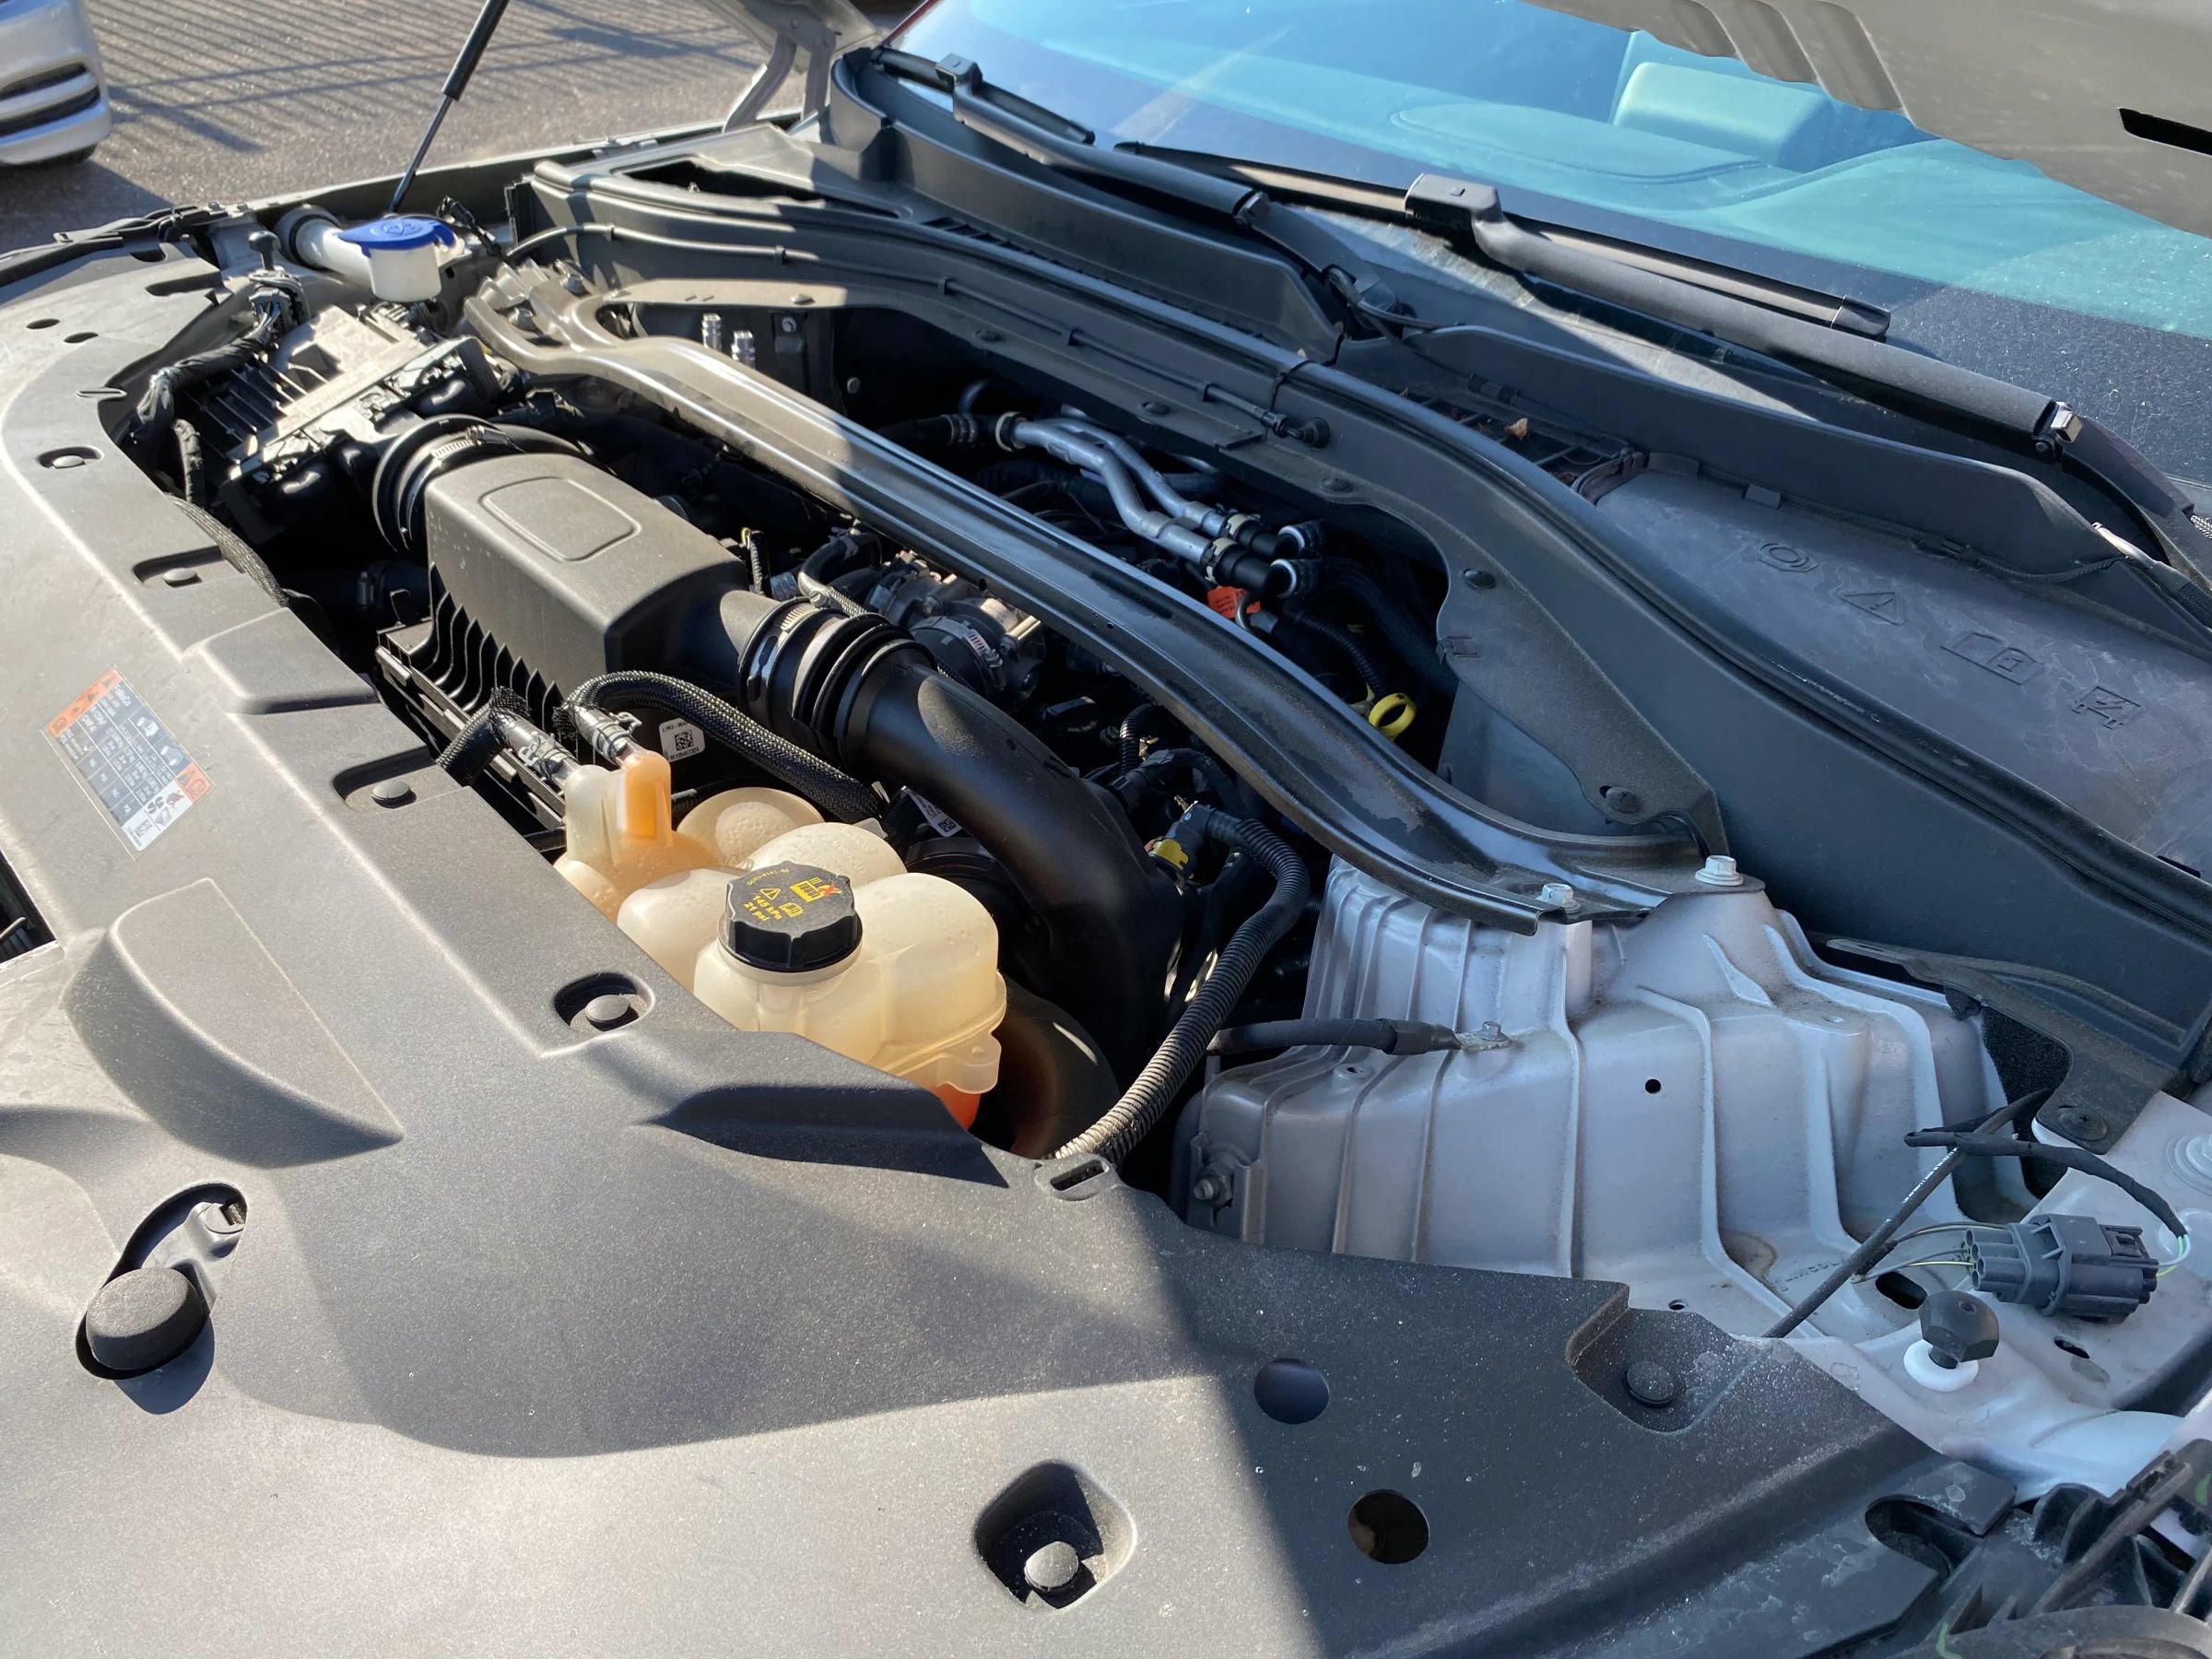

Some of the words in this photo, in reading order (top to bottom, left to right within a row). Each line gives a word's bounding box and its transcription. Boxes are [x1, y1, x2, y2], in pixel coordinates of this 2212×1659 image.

[743, 901, 758, 912] 21
[753, 895, 771, 908] 145
[766, 906, 782, 920] kPa
